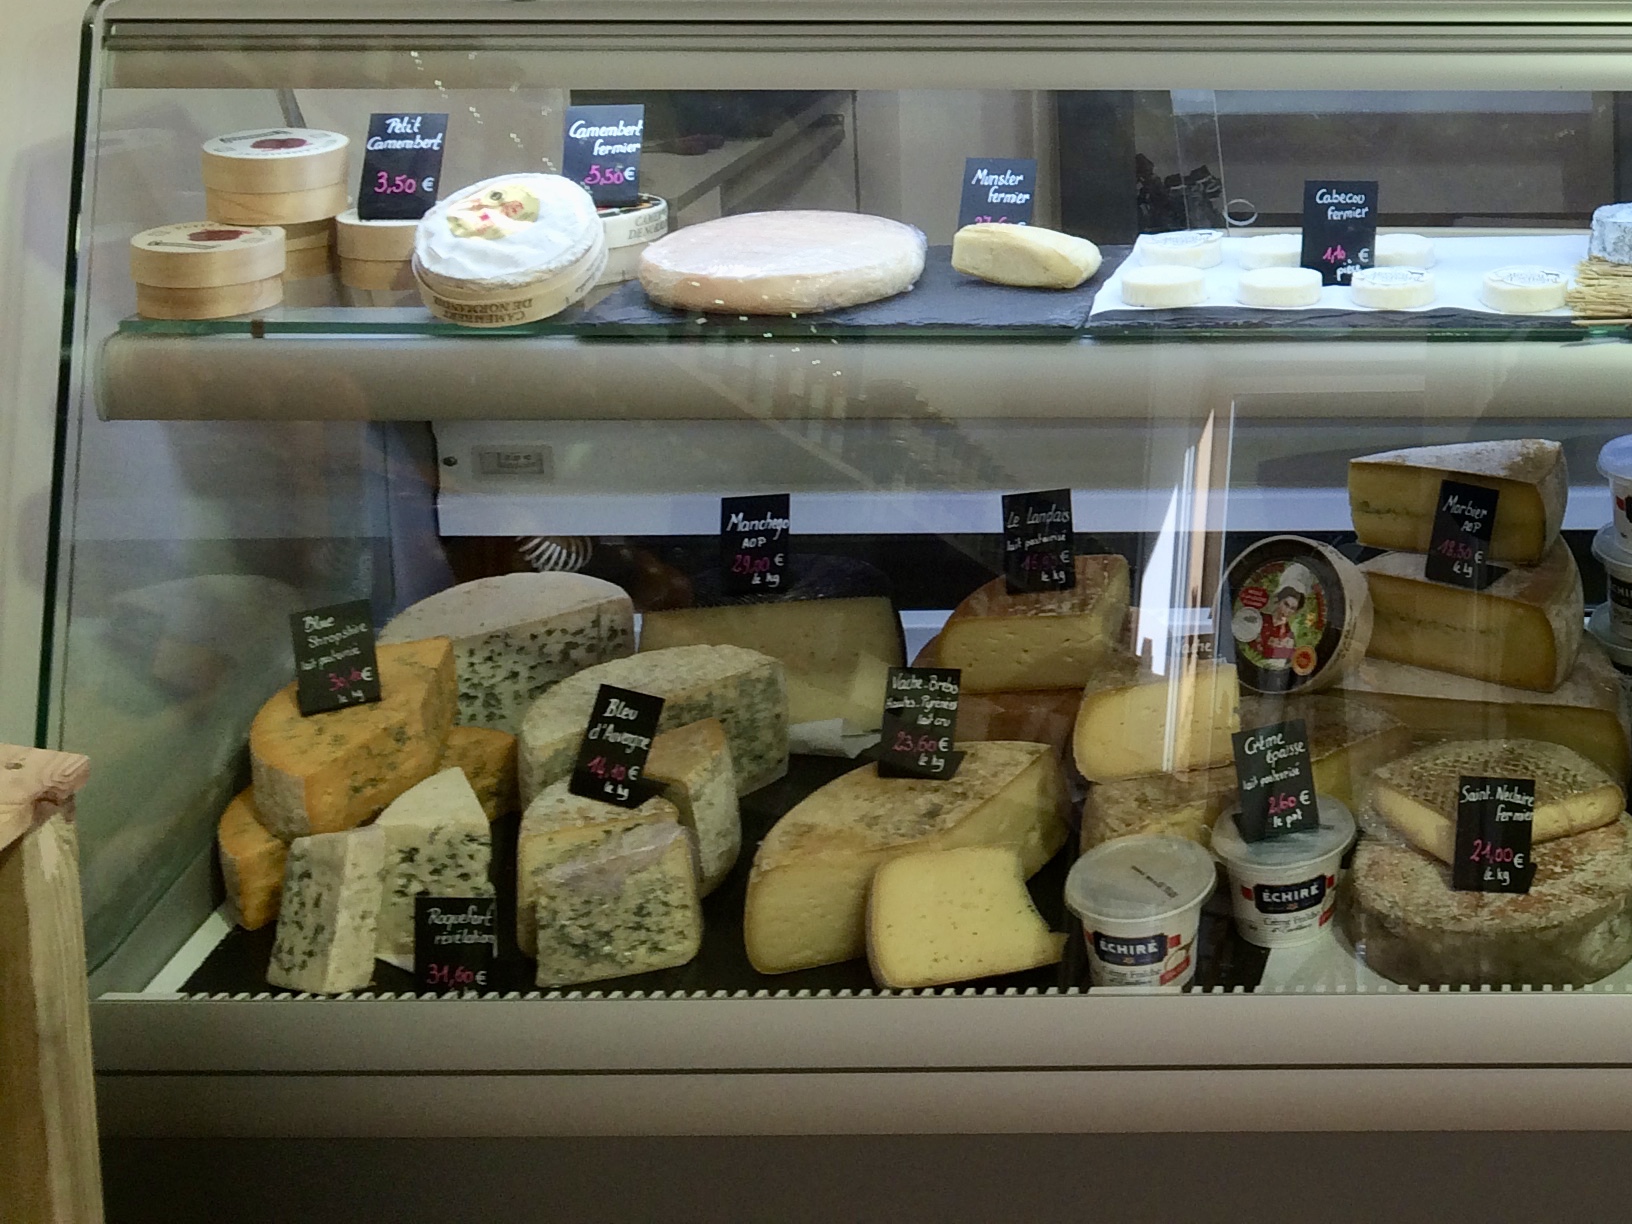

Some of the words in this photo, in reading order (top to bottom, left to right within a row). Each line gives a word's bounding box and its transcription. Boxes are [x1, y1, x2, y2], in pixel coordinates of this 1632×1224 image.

[385, 117, 420, 134] Petit
[568, 120, 643, 138] Camembert
[366, 133, 443, 151] Camembert
[593, 139, 641, 156] fermier
[374, 171, 416, 194] 3,50
[421, 176, 435, 192] €
[971, 168, 1024, 186] Munster
[987, 186, 1031, 204] fermier
[1315, 188, 1366, 205] Cabecou
[1327, 206, 1369, 221] fermier
[1357, 248, 1370, 263] €
[512, 298, 534, 309] DE
[443, 310, 526, 324] CAMEMBERT
[1442, 494, 1488, 519] Morbier
[726, 511, 790, 541] Manchego
[741, 536, 766, 549] AOP
[751, 573, 761, 584] le
[765, 572, 780, 588] kg
[1052, 569, 1066, 584] kg
[602, 698, 639, 721] Bleu
[917, 714, 934, 725] lait
[934, 717, 951, 727] cru
[1244, 733, 1285, 755] Crème
[918, 753, 928, 766] le
[931, 755, 945, 772] kg
[1265, 741, 1306, 768] épaisse
[1285, 808, 1303, 828] pot
[1483, 866, 1495, 881] le
[1497, 867, 1511, 886] kg
[1262, 881, 1319, 902] ÉCHIRÉ
[1100, 938, 1158, 955] ÉCHIRÉ
